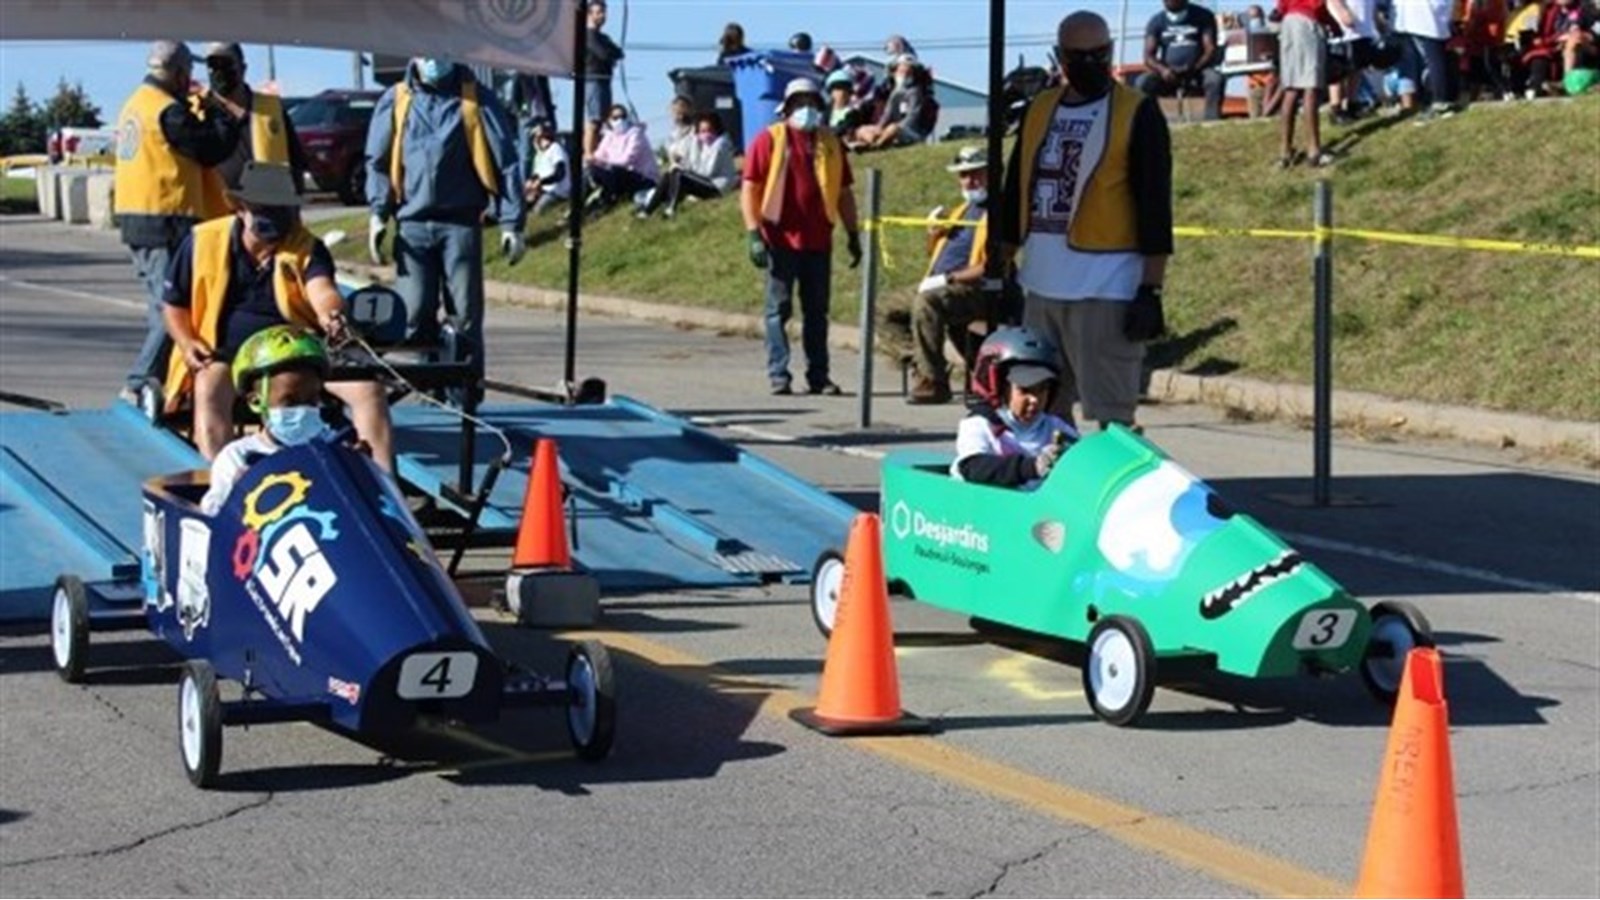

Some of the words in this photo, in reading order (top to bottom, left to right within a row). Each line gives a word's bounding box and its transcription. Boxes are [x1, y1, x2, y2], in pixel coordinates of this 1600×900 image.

[366, 295, 379, 320] 1
[914, 511, 989, 553] Desjardins
[256, 521, 338, 643] SR
[1310, 612, 1339, 647] 3
[420, 656, 453, 693] 4
